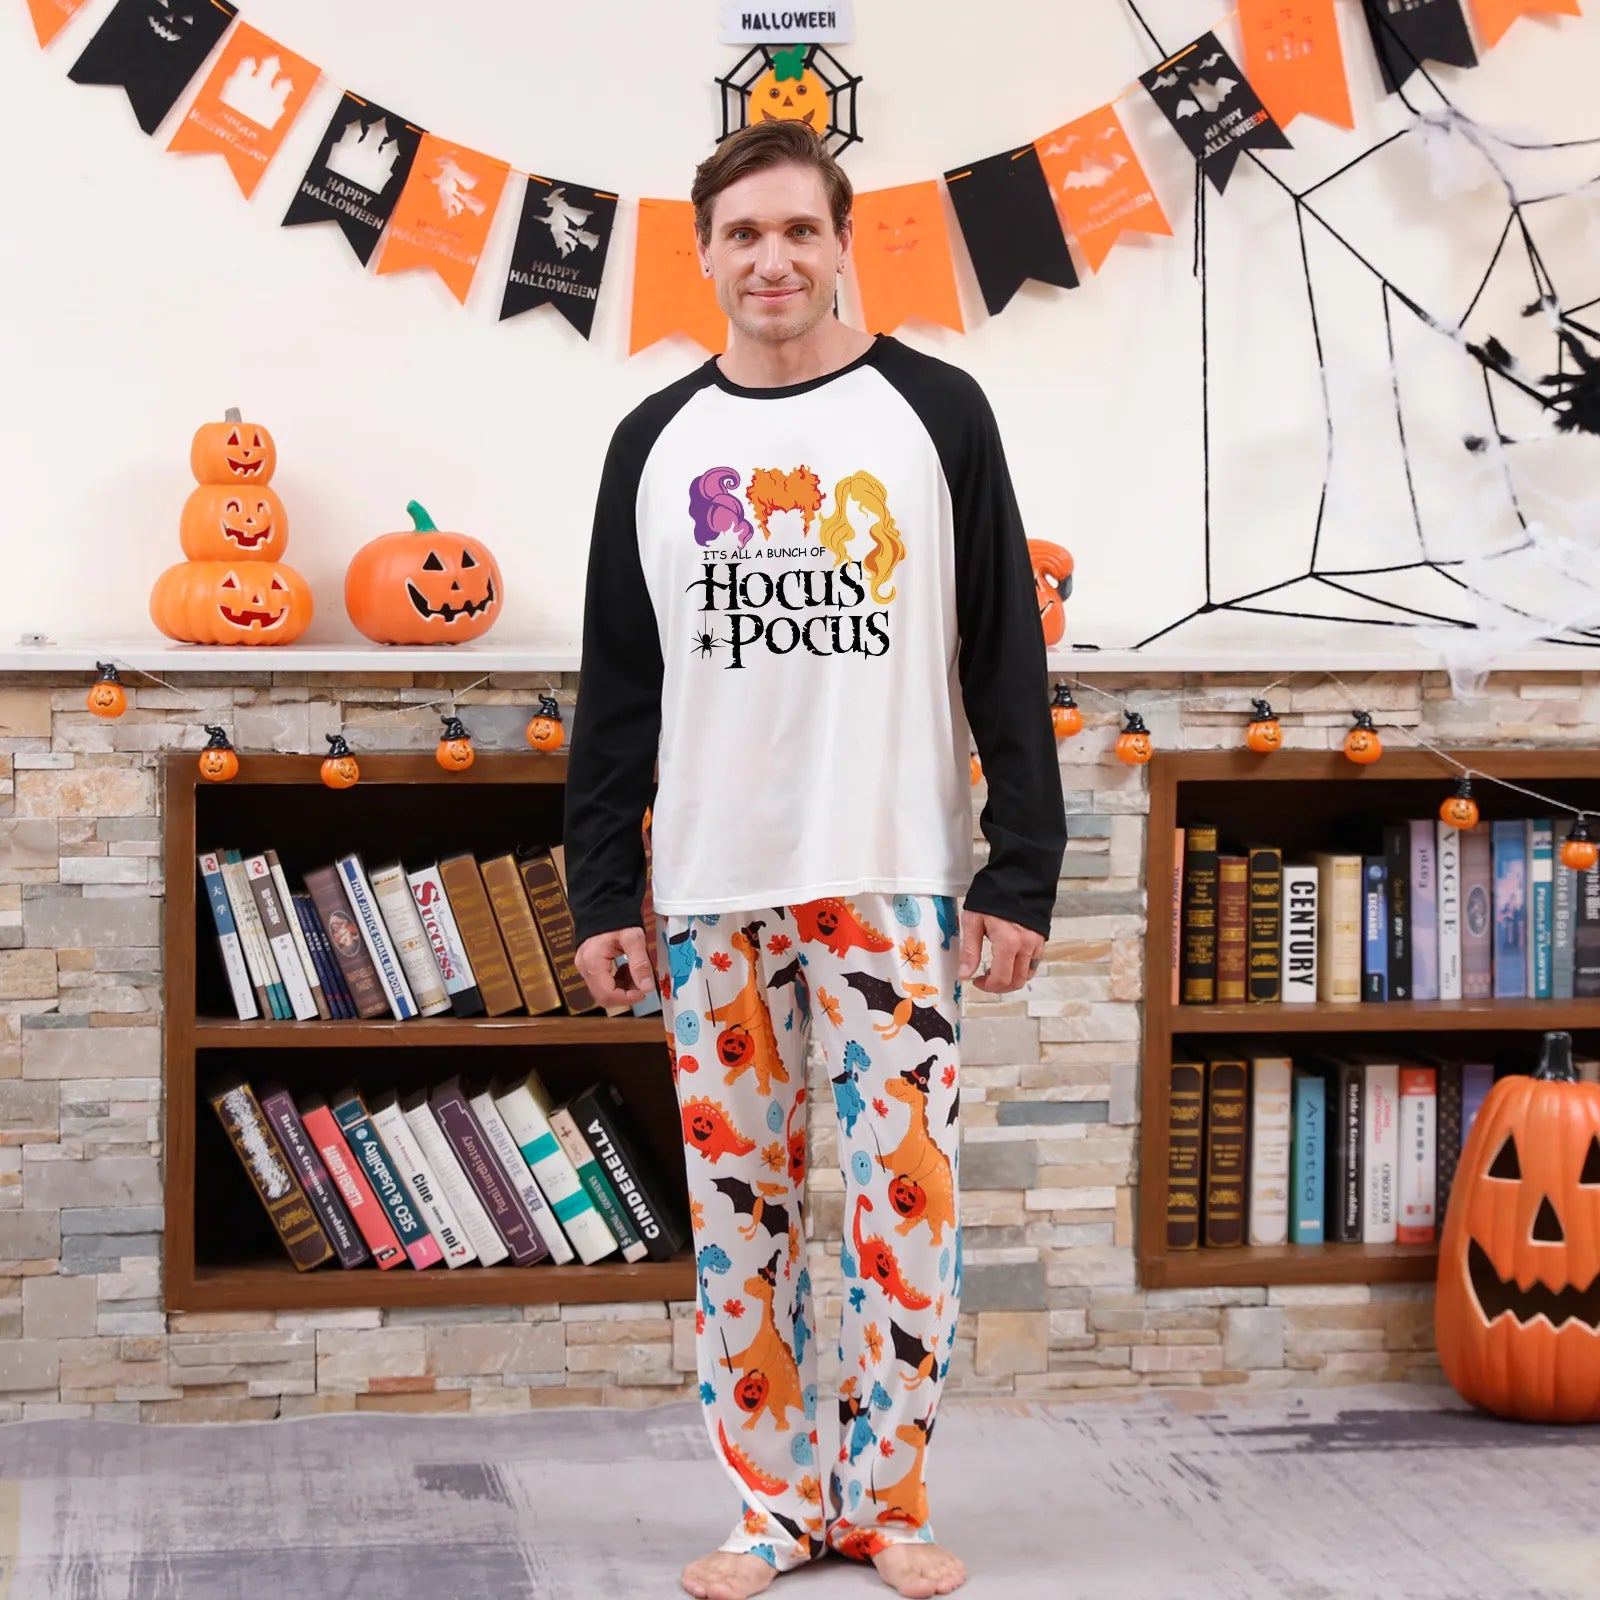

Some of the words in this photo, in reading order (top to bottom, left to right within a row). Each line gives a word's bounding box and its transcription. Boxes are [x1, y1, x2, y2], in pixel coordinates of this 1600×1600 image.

[741, 10, 836, 31] HALLOWEEN
[301, 181, 384, 230] HALLOWEEN
[326, 176, 373, 206] HAPPY
[509, 269, 597, 301] HALLOWEEN
[532, 260, 580, 281] HAPPY
[703, 550, 727, 561] IT'S
[732, 549, 752, 560] ALL
[755, 549, 763, 559] A
[767, 547, 807, 559] BUNCH
[810, 546, 826, 558] OF
[348, 877, 366, 903] THAT
[1444, 832, 1456, 936] VOGUE
[357, 900, 379, 936] JUSTICE
[1556, 911, 1569, 949] Book
[371, 934, 390, 963] SHALL
[1288, 881, 1315, 987] CENTURY
[382, 961, 395, 976] BE
[387, 973, 405, 999] DONE
[485, 1118, 524, 1178] FURNITURE
[280, 1114, 300, 1146] Bride
[296, 1145, 306, 1156] &
[326, 1205, 352, 1249] wedding
[362, 1139, 397, 1196] Usability
[588, 1118, 660, 1239] CINDERELLA
[389, 1195, 403, 1207] &
[412, 1173, 434, 1204] Cine
[395, 1204, 418, 1234] SEO
